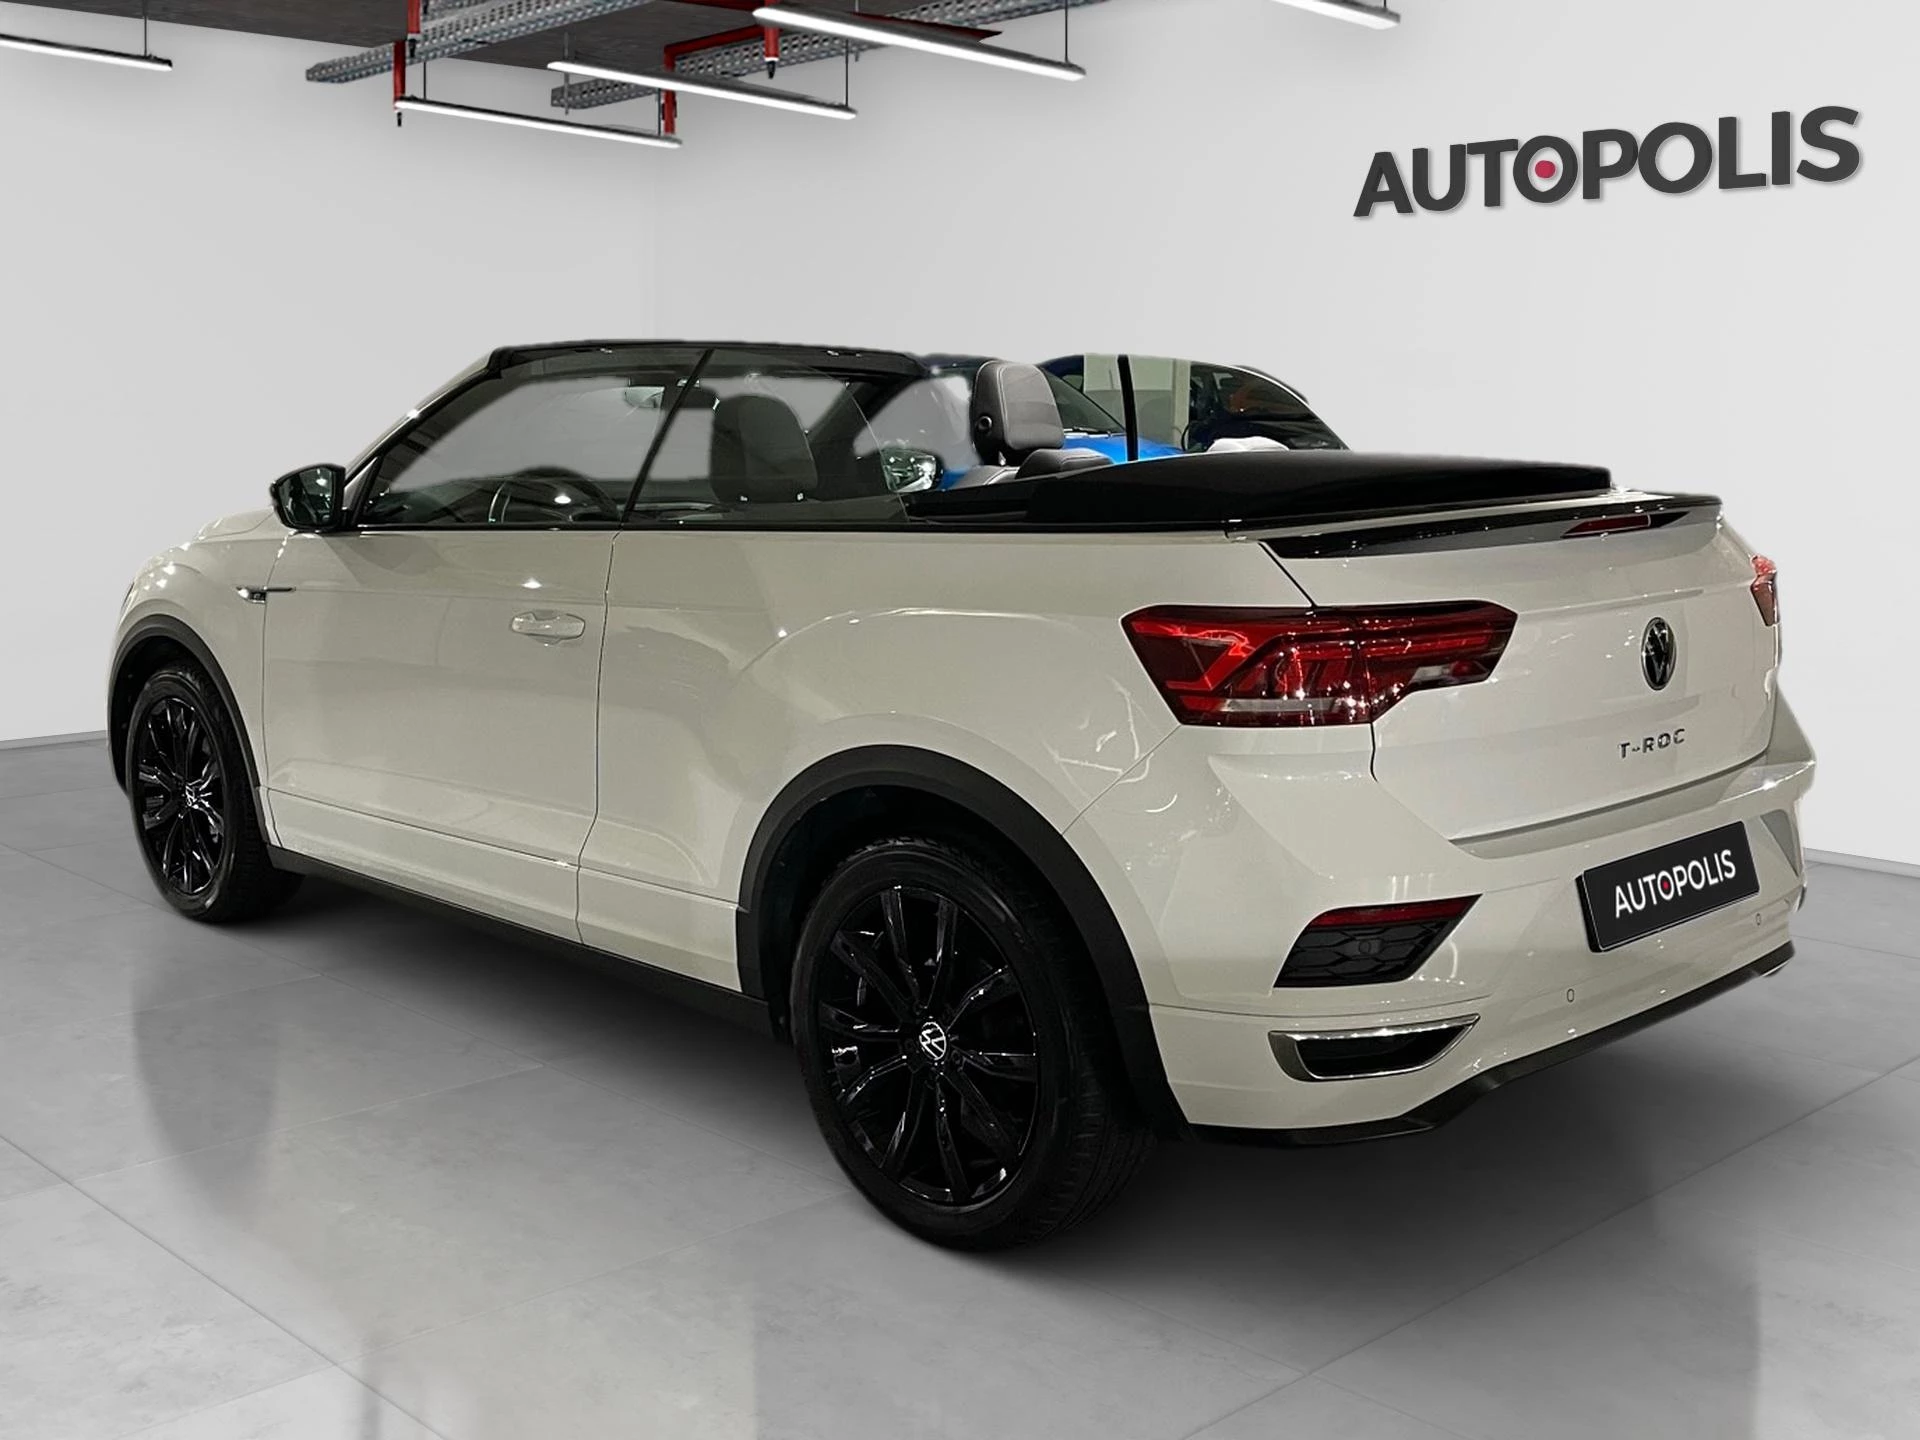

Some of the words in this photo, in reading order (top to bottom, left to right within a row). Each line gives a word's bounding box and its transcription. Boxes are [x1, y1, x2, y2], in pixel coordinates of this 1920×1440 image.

[1353, 105, 1860, 218] AUTOPOLIS
[1620, 728, 1685, 758] T-ROC
[1615, 849, 1737, 918] AUTOPOLIS
